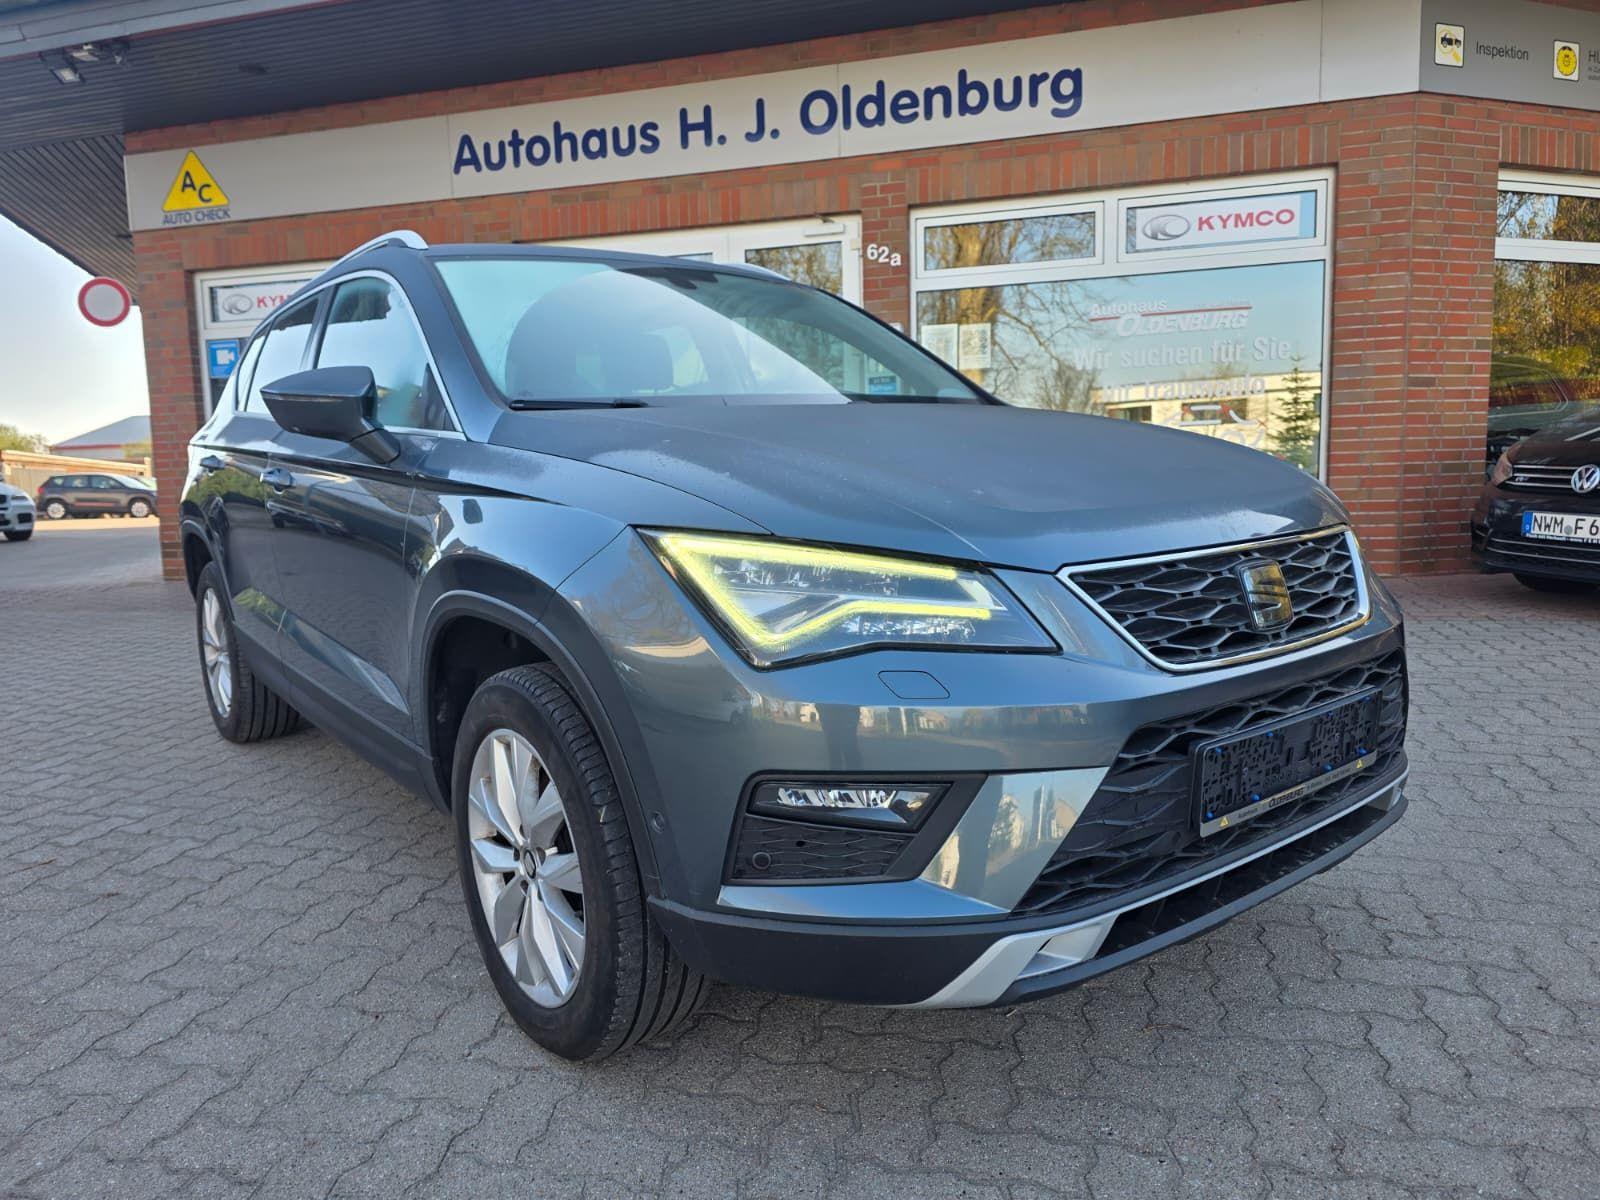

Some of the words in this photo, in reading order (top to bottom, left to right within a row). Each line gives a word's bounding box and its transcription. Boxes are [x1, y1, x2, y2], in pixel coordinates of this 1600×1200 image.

[1475, 41, 1529, 61] Inspektion
[453, 119, 660, 175] Autohaus
[679, 104, 727, 149] H.
[745, 97, 781, 143] J.
[800, 67, 1083, 138] Oldenburg
[162, 211, 193, 225] AUTO
[194, 208, 232, 222] CHECK
[1197, 208, 1296, 232] KYMCO
[866, 242, 902, 268] 62a
[1090, 300, 1168, 317] Autohaus
[1116, 311, 1249, 337] OLDENBURG
[1073, 348, 1112, 370] Wir
[1120, 343, 1201, 368] suchen
[1210, 339, 1245, 363] für
[1253, 336, 1291, 361] Sie
[1532, 515, 1564, 534] NWM
